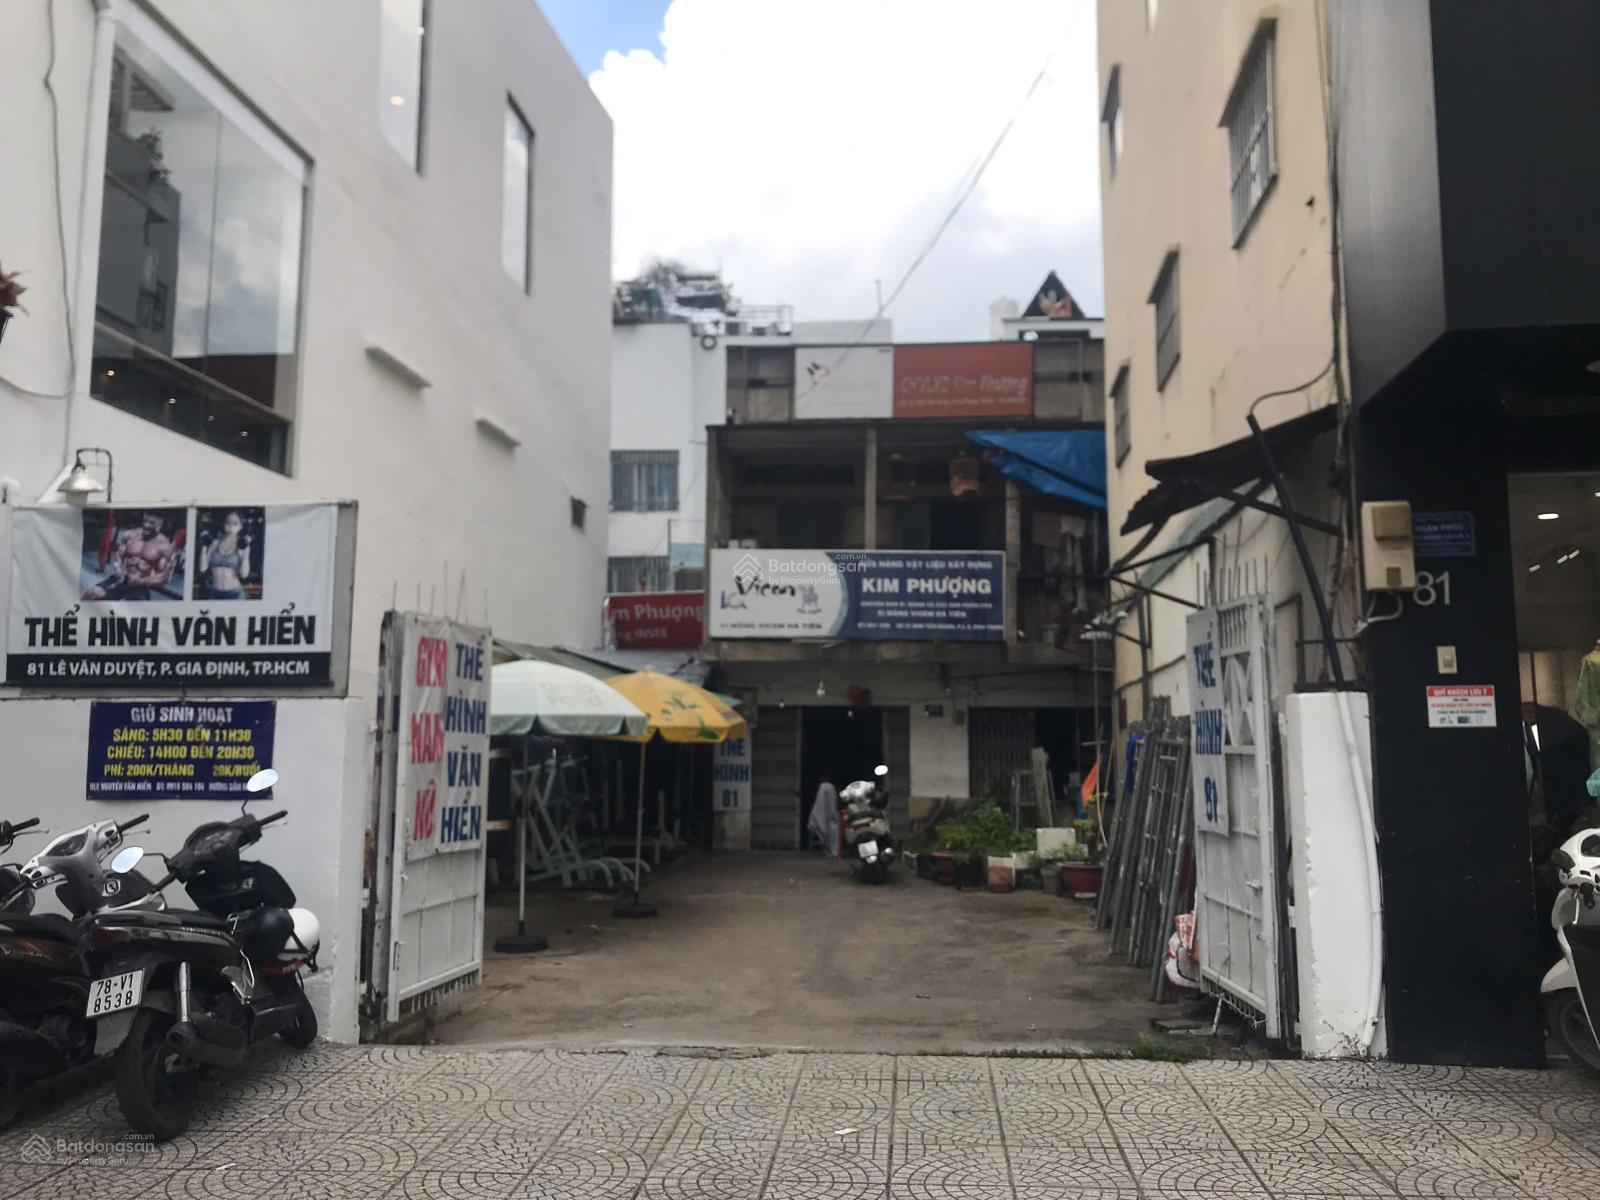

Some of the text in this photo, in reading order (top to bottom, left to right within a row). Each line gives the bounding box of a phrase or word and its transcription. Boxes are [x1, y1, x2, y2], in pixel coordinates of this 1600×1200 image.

[862, 576, 991, 598] KIM PHƯỢNG
[1413, 570, 1450, 606] 81
[24, 602, 316, 647] THỂ HÌNH VĂN HIỂN
[27, 659, 309, 680] 81 LÊ VĂN DUYỆT, P. GIA ĐỊNH, TP.HCM
[416, 636, 448, 687] GYM
[456, 635, 484, 682] THỂ
[131, 704, 233, 726] GIỜ SINH HOẠT
[445, 689, 487, 734] HÌNH
[107, 742, 254, 759] CHIỀU: 14H00 ĐẾN 20H30
[113, 724, 252, 742] SÁNG: 5H30 ĐẾN 11H30
[411, 713, 445, 764] NAM
[104, 762, 124, 776] PHÍ:
[127, 762, 194, 777] 200K/THÁNG
[447, 744, 481, 787] VĂN
[440, 790, 482, 844] HIỂN
[1204, 776, 1218, 823] 81
[94, 990, 133, 1013] 8538
[97, 974, 133, 997] 78-V1
